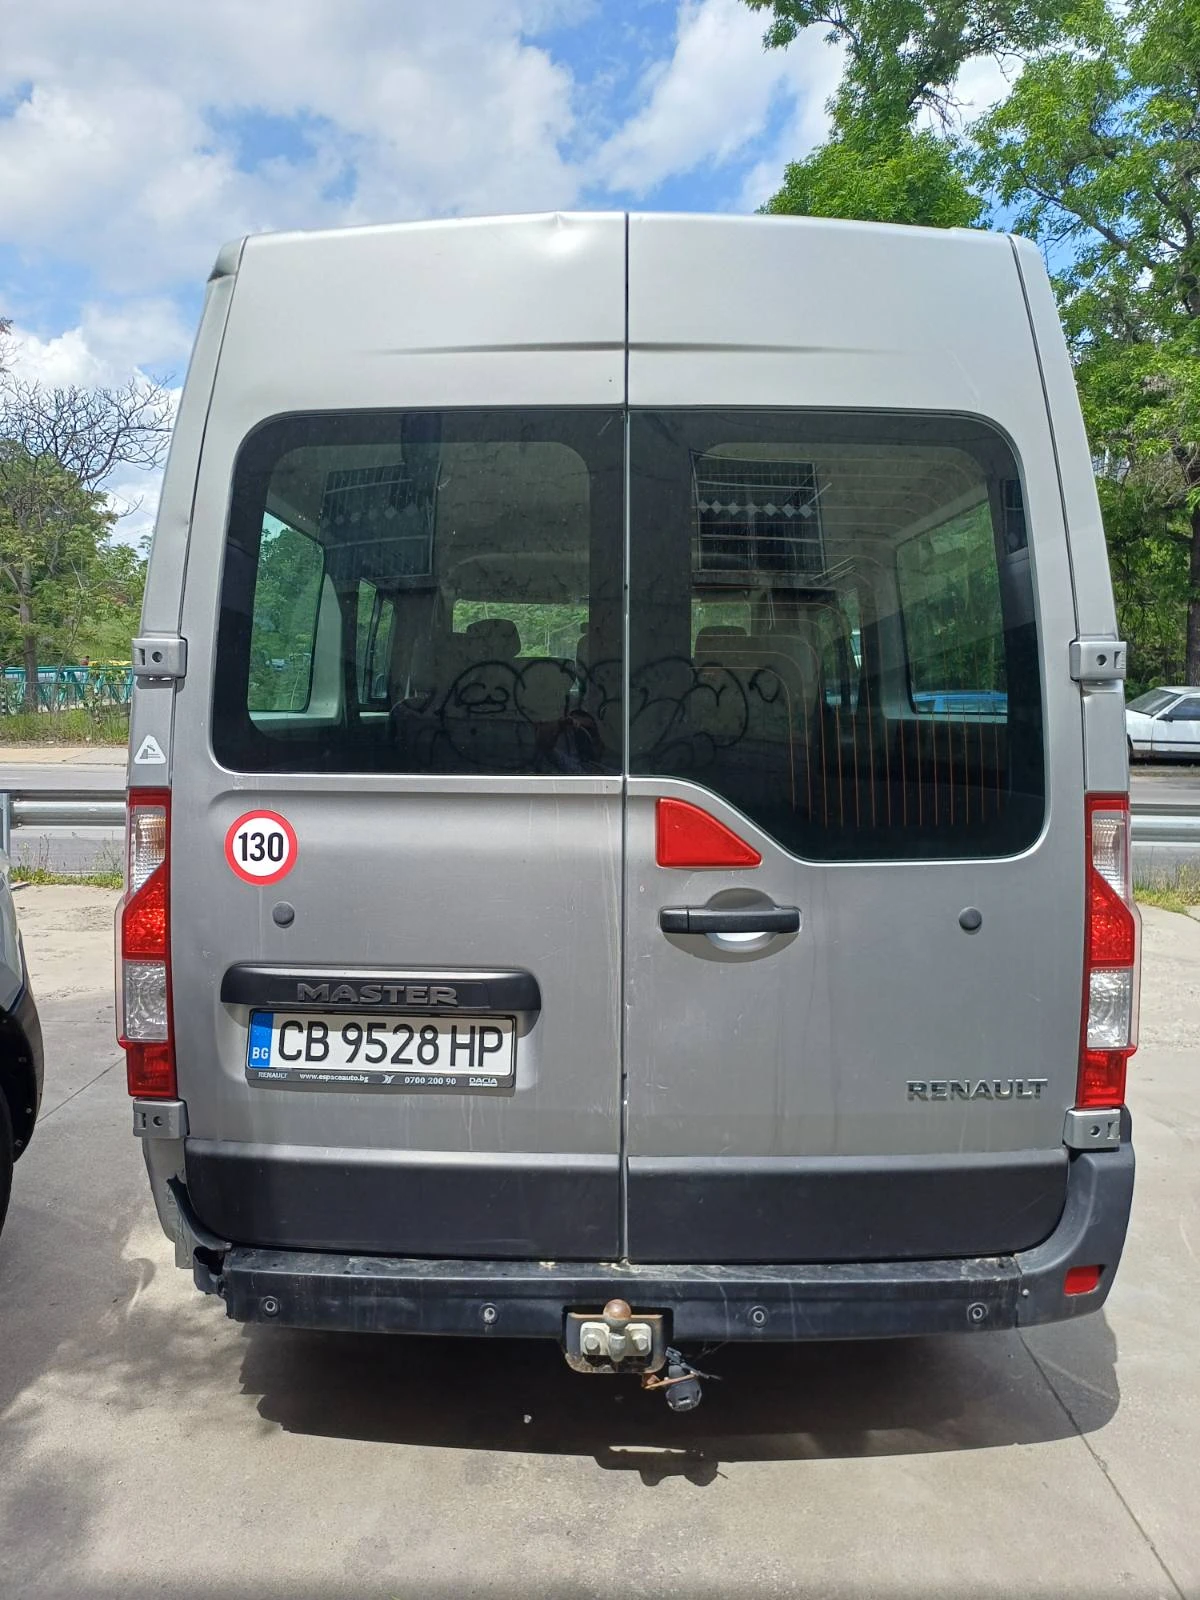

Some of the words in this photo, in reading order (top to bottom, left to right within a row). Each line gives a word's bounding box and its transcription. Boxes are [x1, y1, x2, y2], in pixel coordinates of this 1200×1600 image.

[238, 832, 284, 862] 130
[297, 983, 458, 1005] MASTER
[278, 1020, 330, 1062] CB
[341, 1022, 440, 1066] 9528
[449, 1025, 504, 1067] HP
[252, 1047, 269, 1059] BG
[258, 1071, 288, 1080] RENAULT
[299, 1073, 369, 1084] www.espaceauto.bg
[404, 1076, 426, 1084] 0700
[428, 1077, 444, 1085] 200
[445, 1077, 457, 1085] 90
[469, 1077, 498, 1086] DACIA
[906, 1078, 1048, 1101] RENAULT
